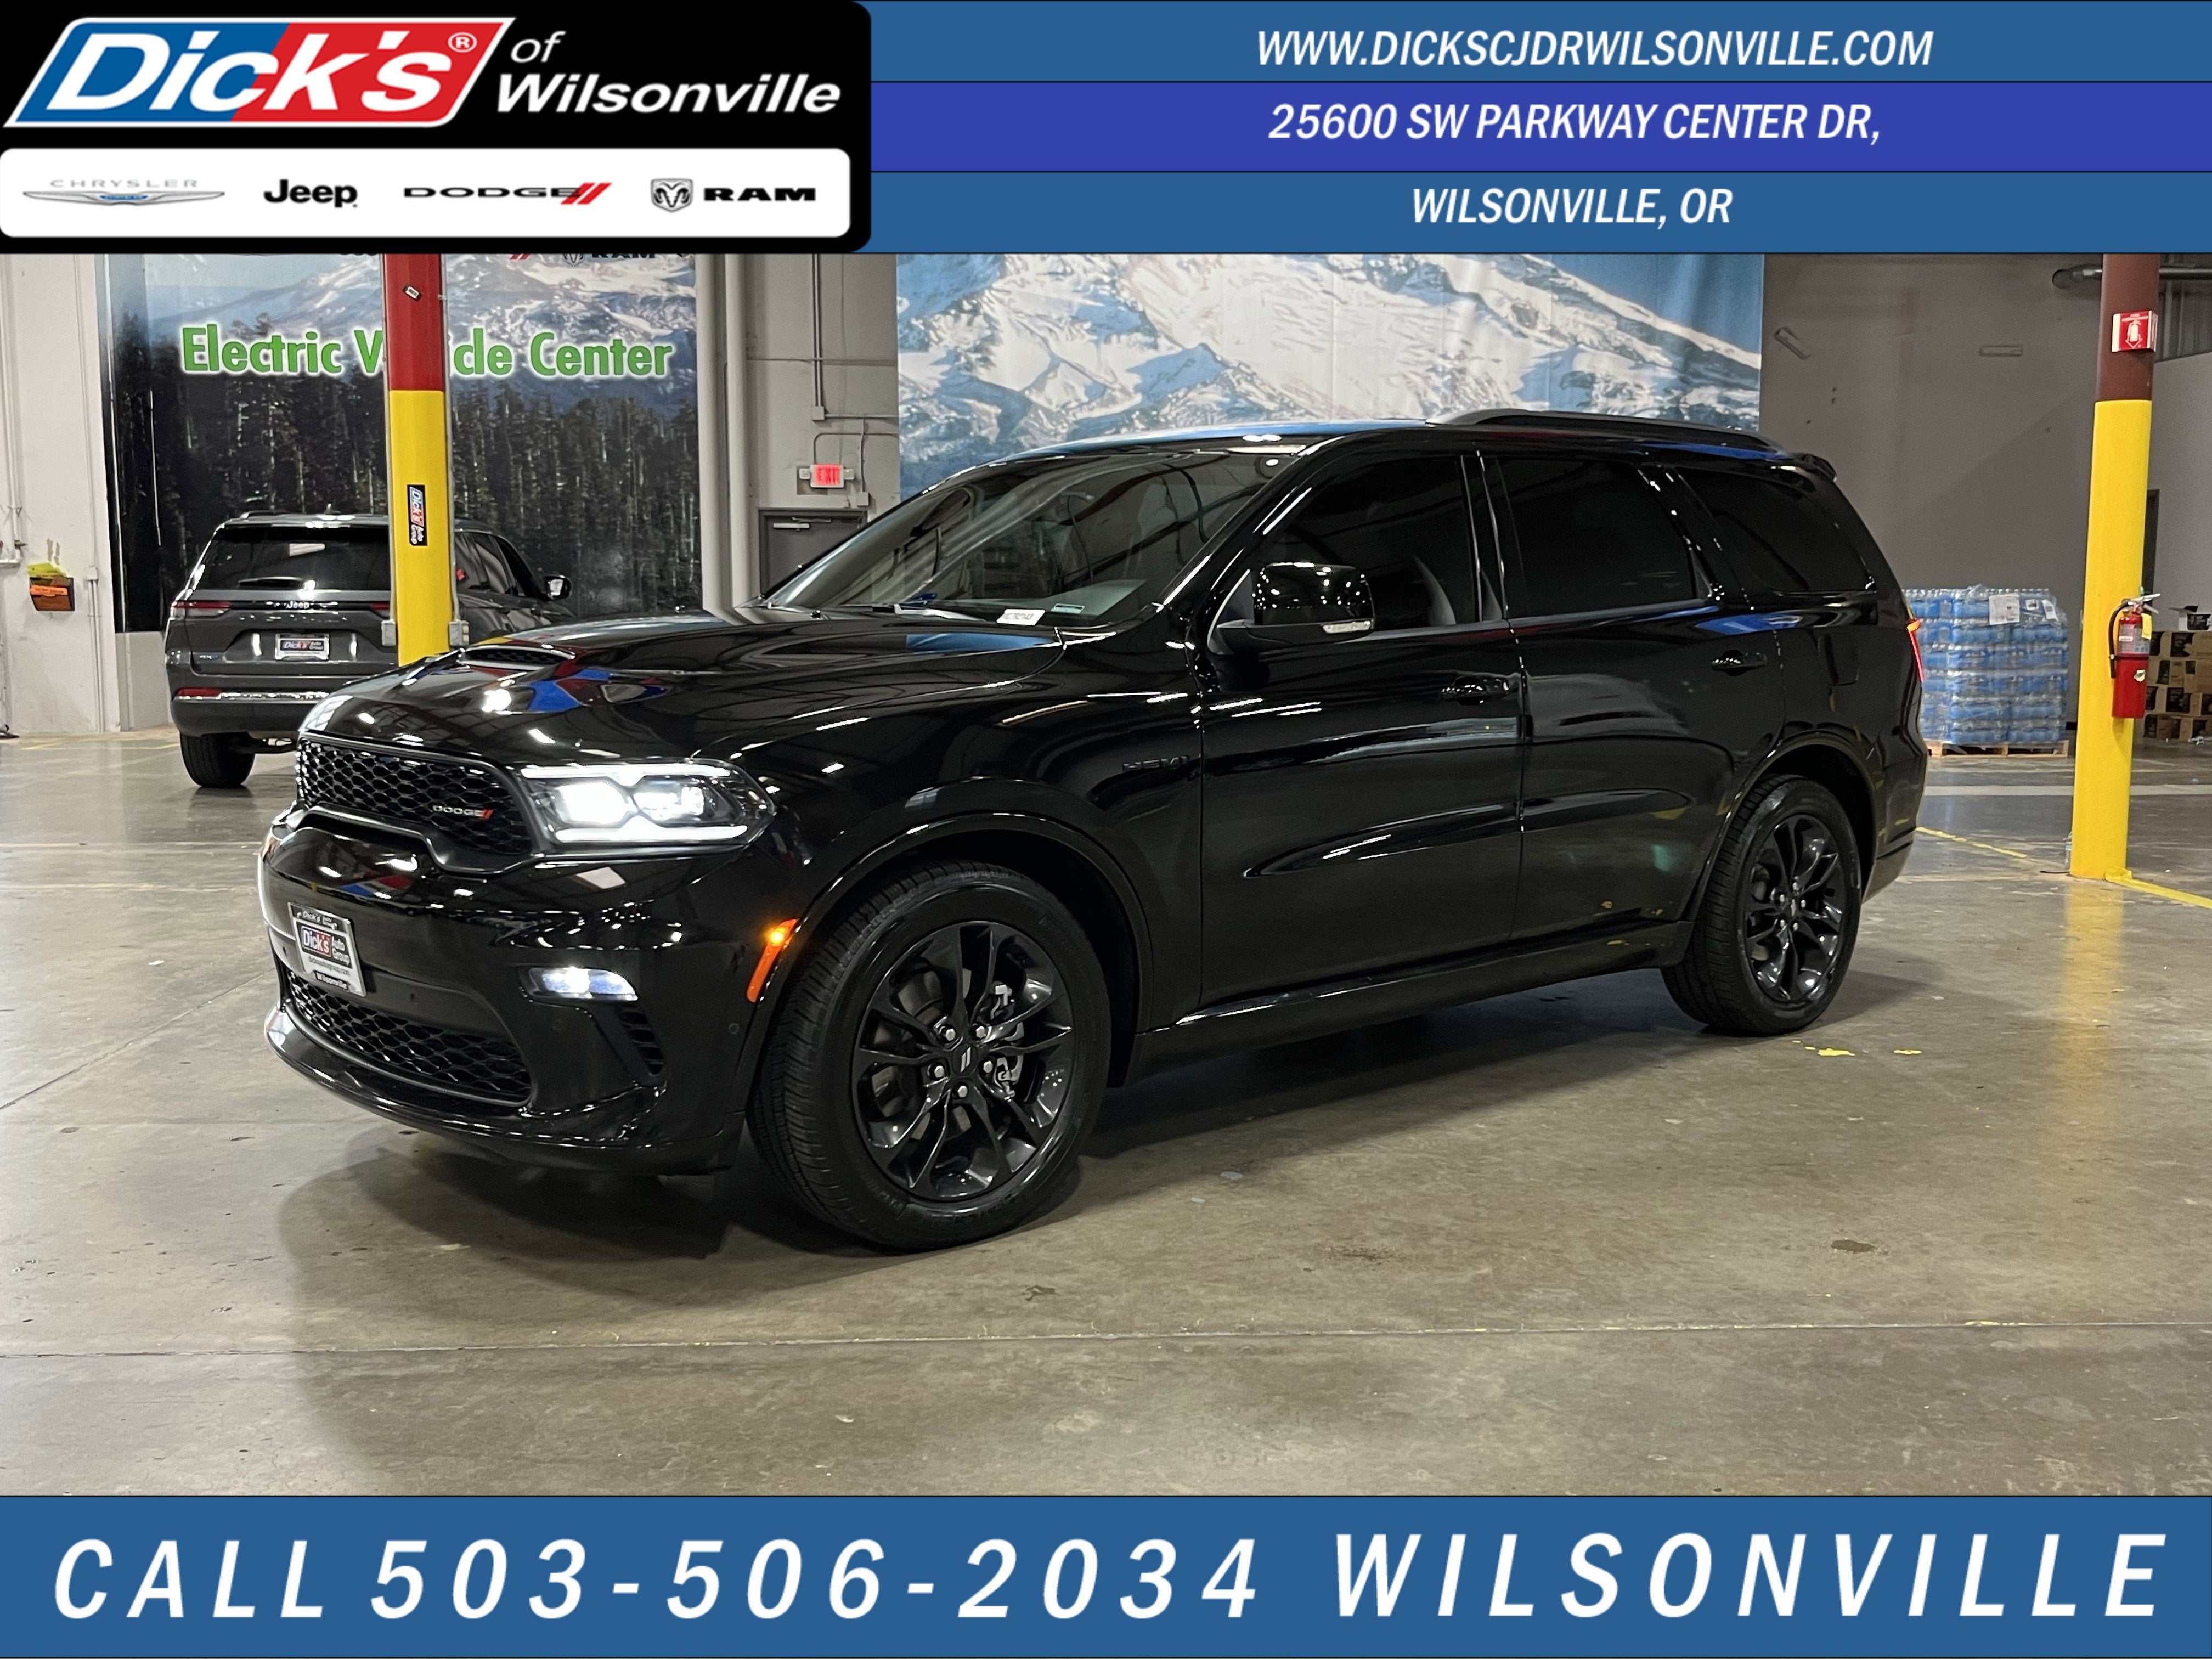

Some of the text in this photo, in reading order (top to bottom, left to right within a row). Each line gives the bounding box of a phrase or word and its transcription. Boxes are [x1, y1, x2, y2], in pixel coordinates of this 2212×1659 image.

[182, 323, 672, 375] Electric Vcle Center
[432, 805, 485, 817] DODGE
[303, 929, 330, 953] Dick's
